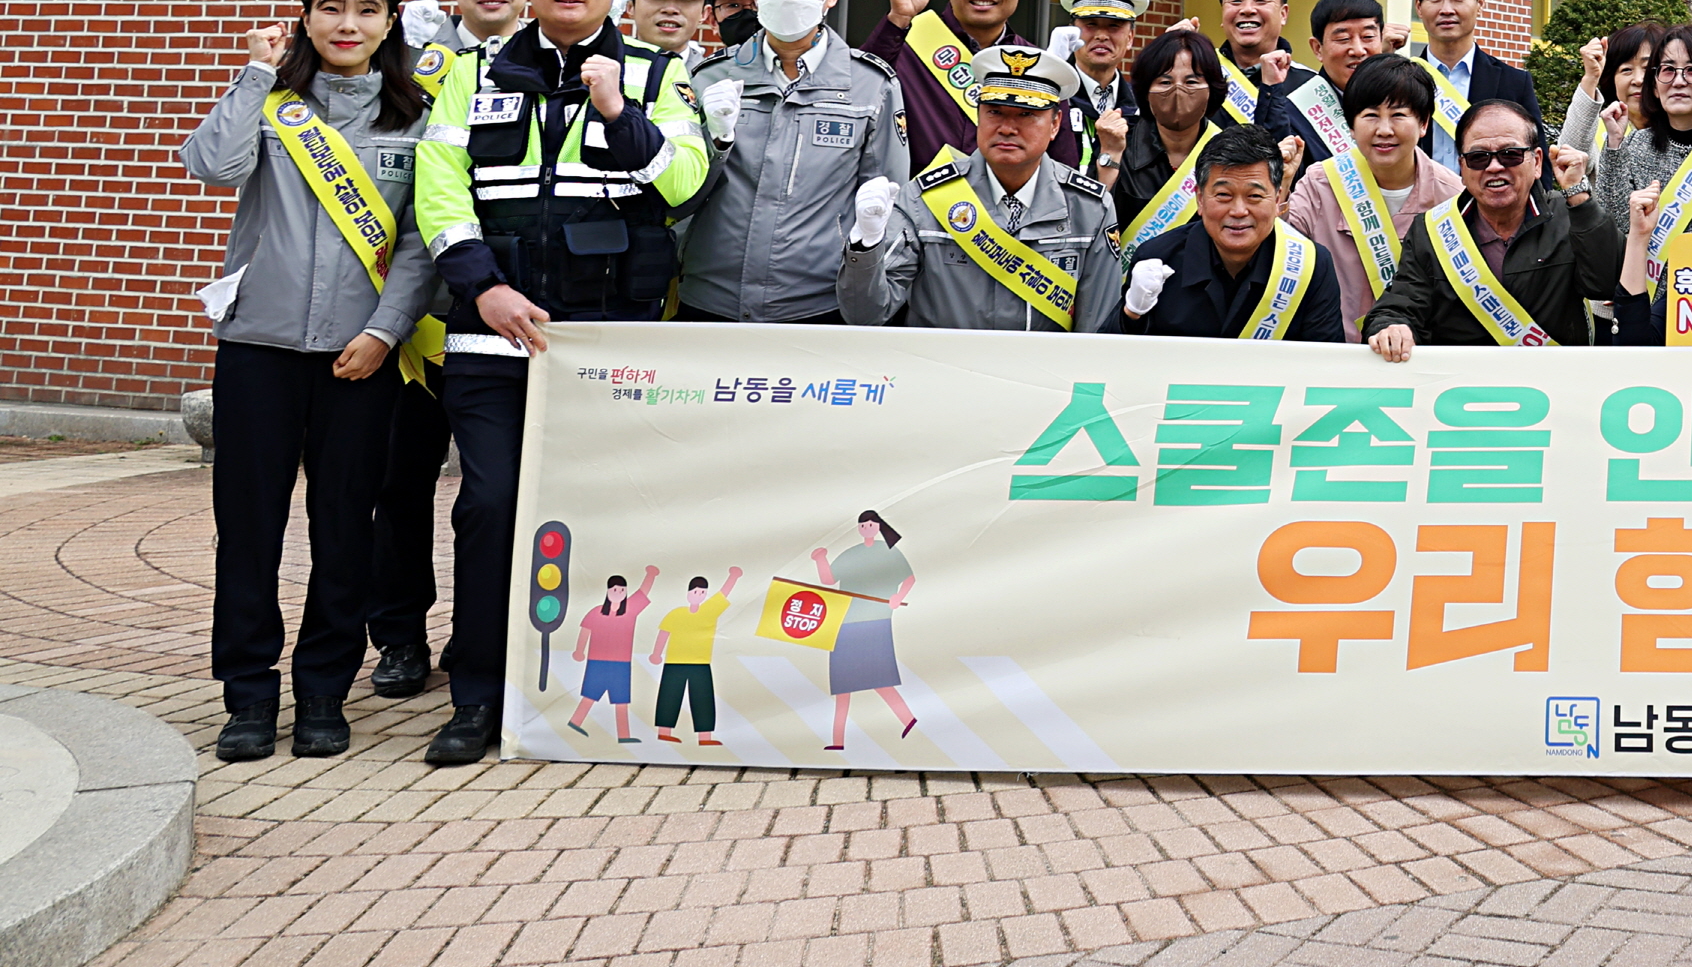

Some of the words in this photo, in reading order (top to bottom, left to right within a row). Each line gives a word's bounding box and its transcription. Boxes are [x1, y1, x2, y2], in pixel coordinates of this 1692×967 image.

[474, 112, 514, 121] POLICE
[477, 97, 518, 113] 경찰
[816, 136, 851, 145] POLICE
[818, 121, 851, 135] 경찰
[381, 169, 412, 180] POLICE
[383, 153, 413, 170] 경찰
[297, 126, 348, 183] 횡단보도에
[333, 177, 368, 215] 사람이
[353, 210, 389, 247] 보이면
[1355, 201, 1381, 232] 함께
[1647, 201, 1681, 256] 스마트폰
[971, 229, 1025, 274] 횡단보도에
[1018, 264, 1054, 295] 사람이
[1286, 240, 1302, 274] 걸을
[1438, 219, 1460, 253] 걸을
[1452, 250, 1477, 283] 때는
[1474, 285, 1523, 337] 스마트폰
[1272, 277, 1297, 310] 때는
[577, 368, 608, 380] 구민을
[610, 366, 656, 384] 편하게
[612, 389, 643, 401] 경제를
[645, 385, 706, 406] 활기차게
[714, 377, 797, 403] 남동을
[801, 378, 886, 406] 새롭게
[1009, 382, 1551, 507] 스쿨존을
[1247, 520, 1556, 674] 우리
[784, 615, 818, 631] STOP
